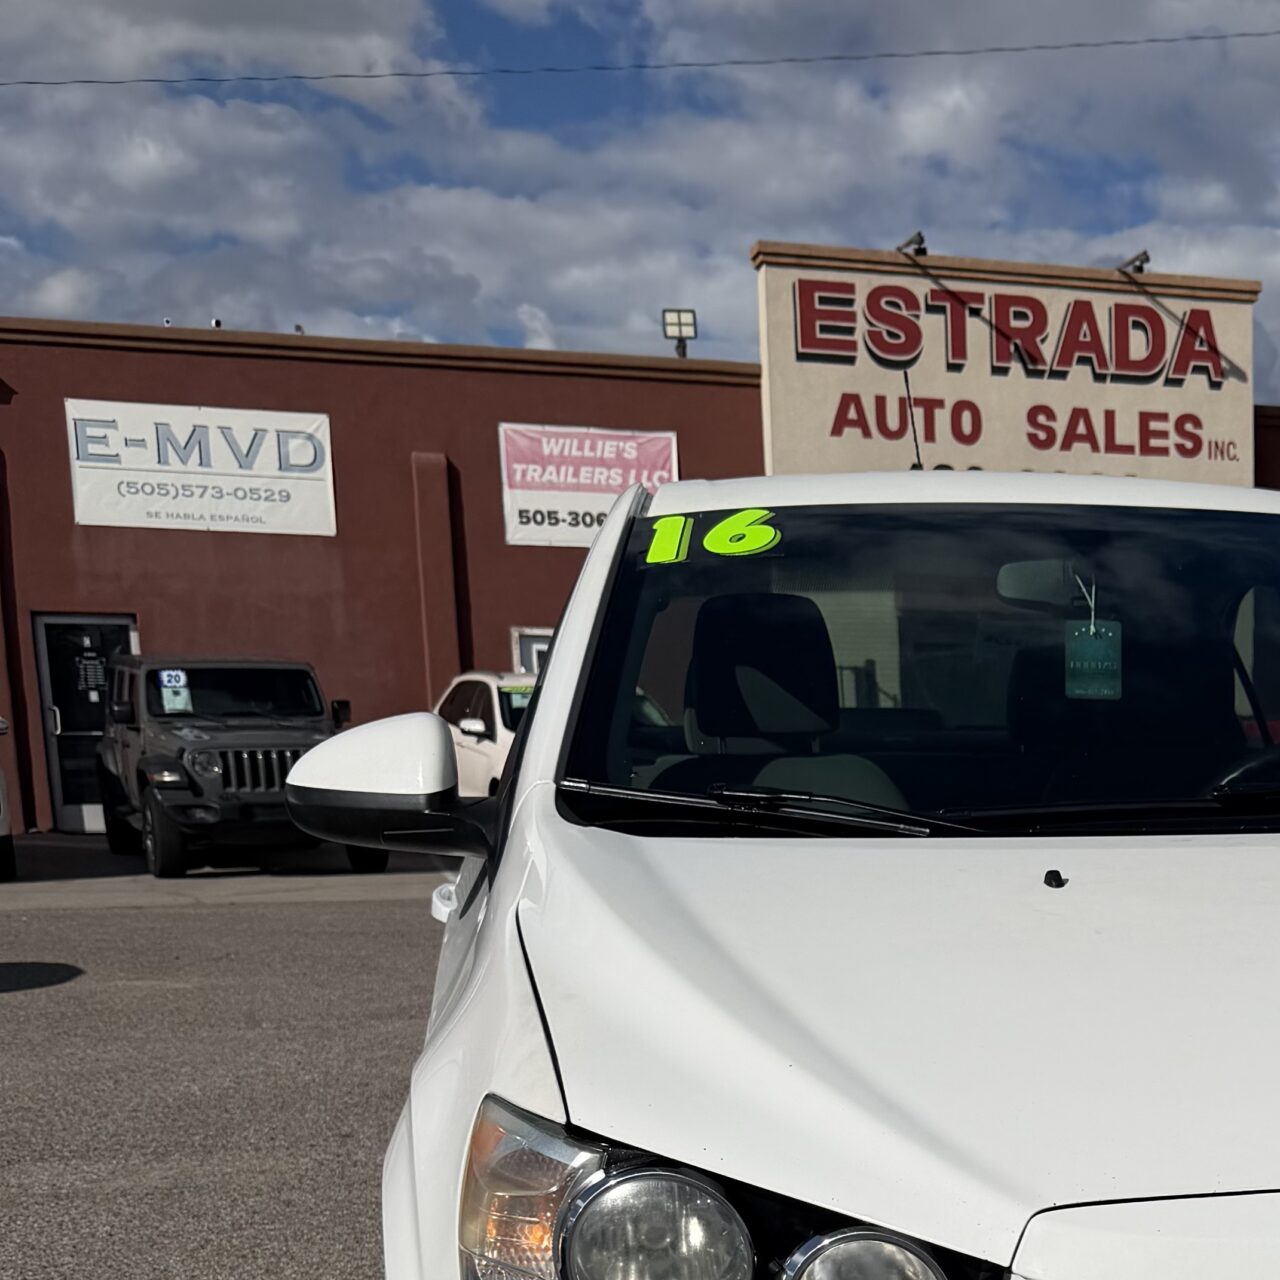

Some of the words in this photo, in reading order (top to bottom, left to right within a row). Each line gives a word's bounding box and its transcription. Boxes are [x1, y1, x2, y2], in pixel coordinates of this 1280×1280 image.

[794, 279, 1225, 390] ESTRADA
[830, 392, 983, 446] AUTO
[1026, 404, 1203, 459] SALES
[1207, 440, 1240, 463] INC.
[72, 418, 326, 473] E-MVD
[541, 437, 638, 460] WILLIE'S
[512, 463, 623, 486] TRAILERS
[116, 480, 292, 504] (505)573-0529
[146, 510, 162, 520] SE
[166, 511, 206, 522] HABLA
[646, 508, 782, 564] 16
[166, 673, 181, 684] 20
